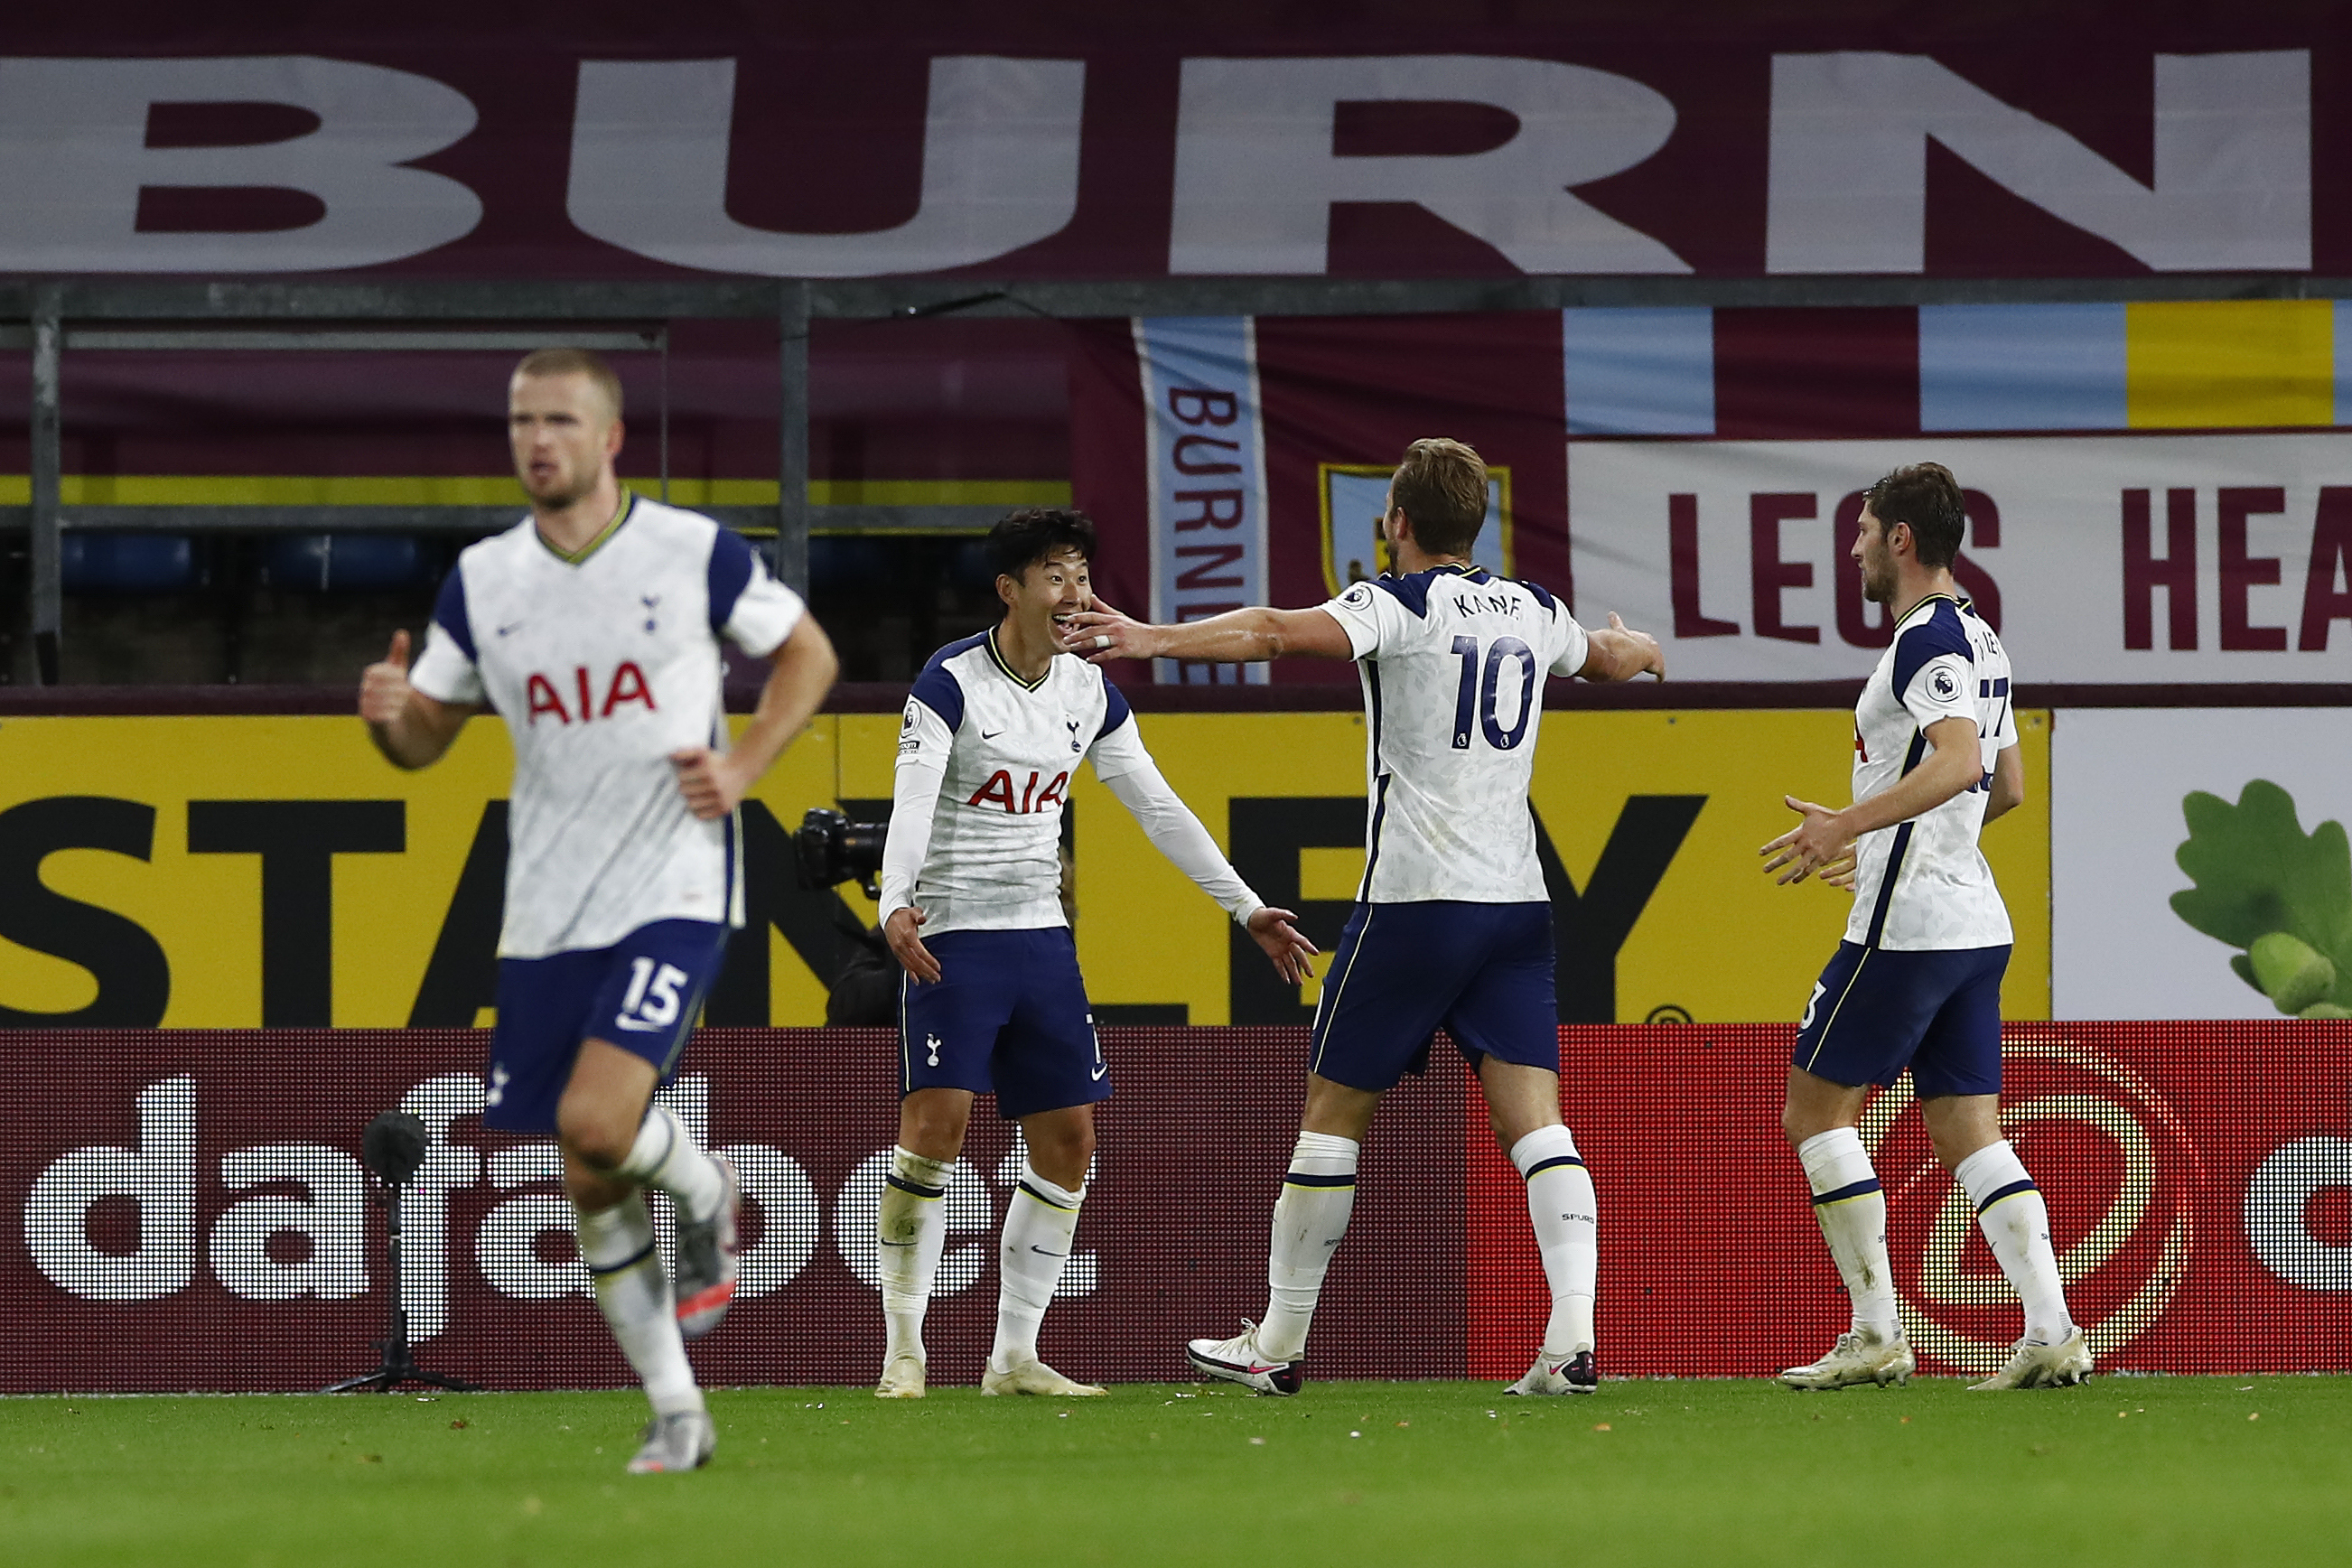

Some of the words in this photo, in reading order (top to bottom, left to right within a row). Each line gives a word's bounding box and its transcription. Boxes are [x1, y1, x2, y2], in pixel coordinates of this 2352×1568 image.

[0, 49, 2312, 278] BURN
[2123, 486, 2352, 651] HEA
[1452, 593, 1522, 621] KANE
[527, 662, 657, 725] AIA
[1451, 635, 1535, 751] 10
[968, 770, 1069, 814] AIA
[621, 956, 688, 1027] 15
